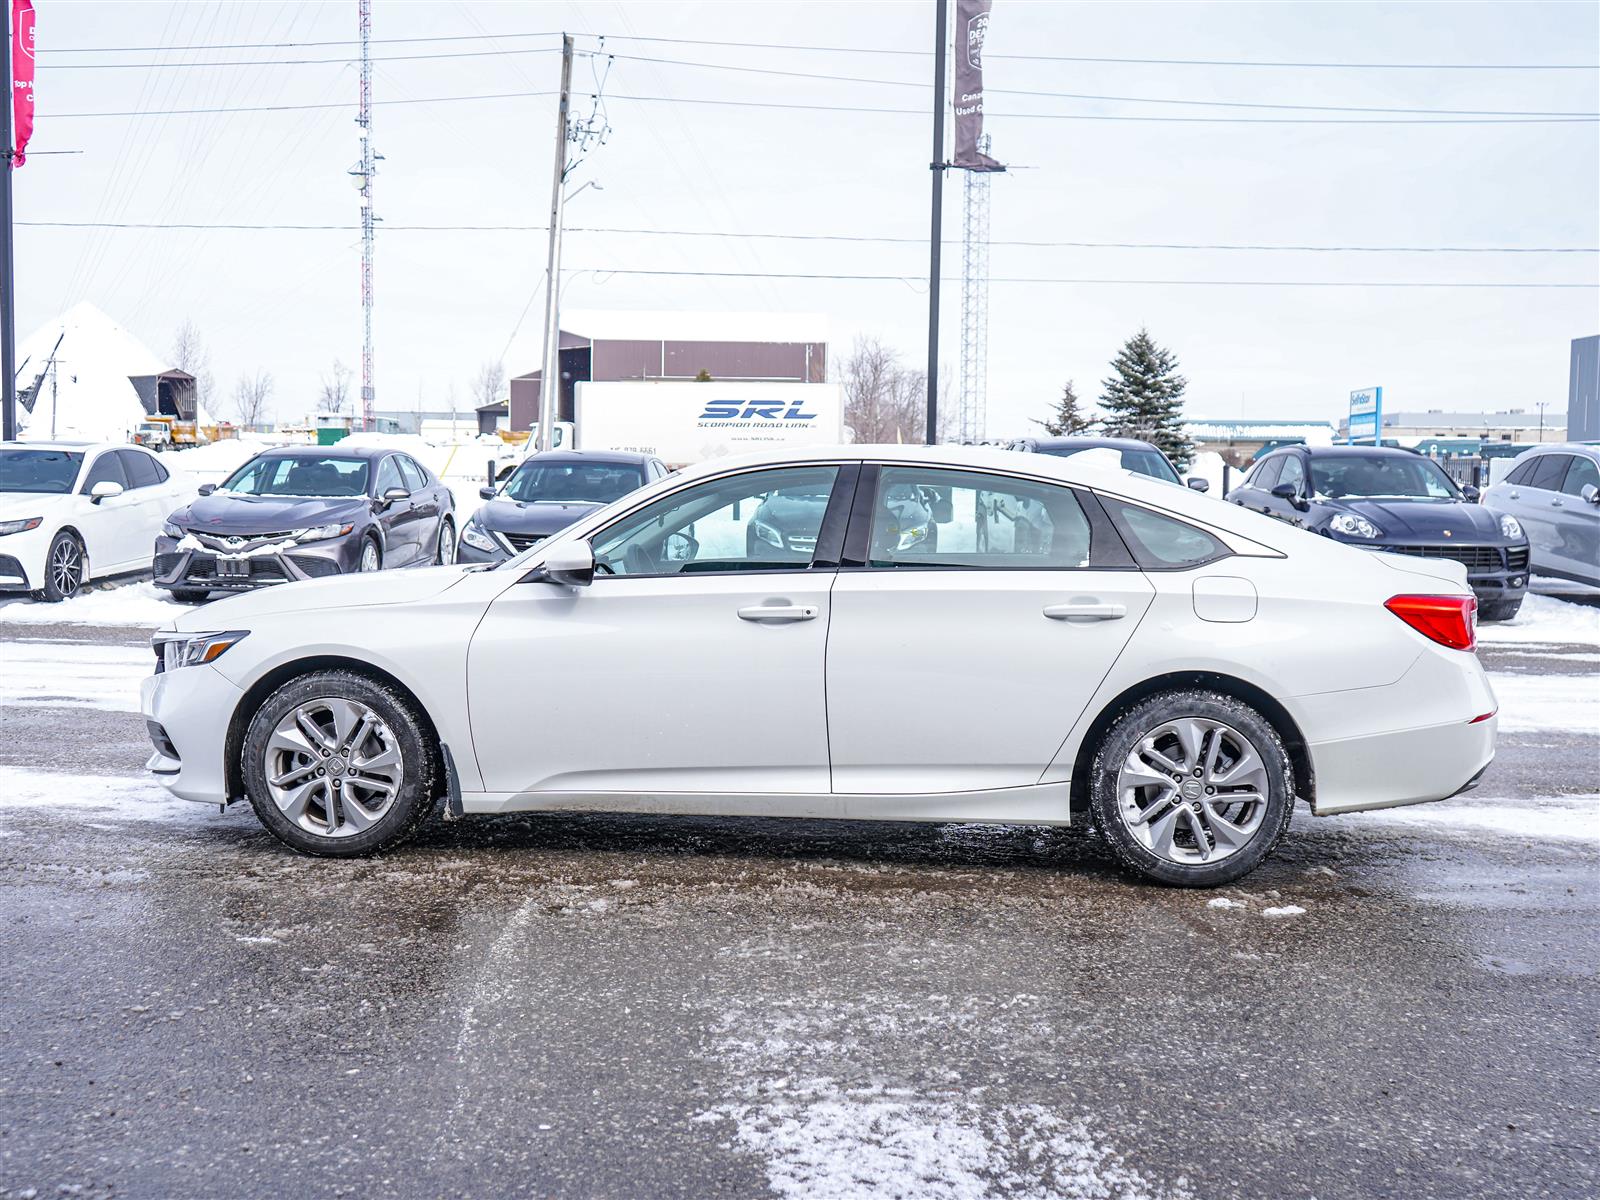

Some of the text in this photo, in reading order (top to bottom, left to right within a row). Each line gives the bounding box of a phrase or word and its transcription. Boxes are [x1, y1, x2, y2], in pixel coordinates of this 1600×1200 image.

[14, 80, 27, 89] Top
[956, 105, 976, 116] Used
[698, 399, 819, 419] SRL
[697, 421, 752, 429] SCORPION
[752, 421, 784, 429] ROAD
